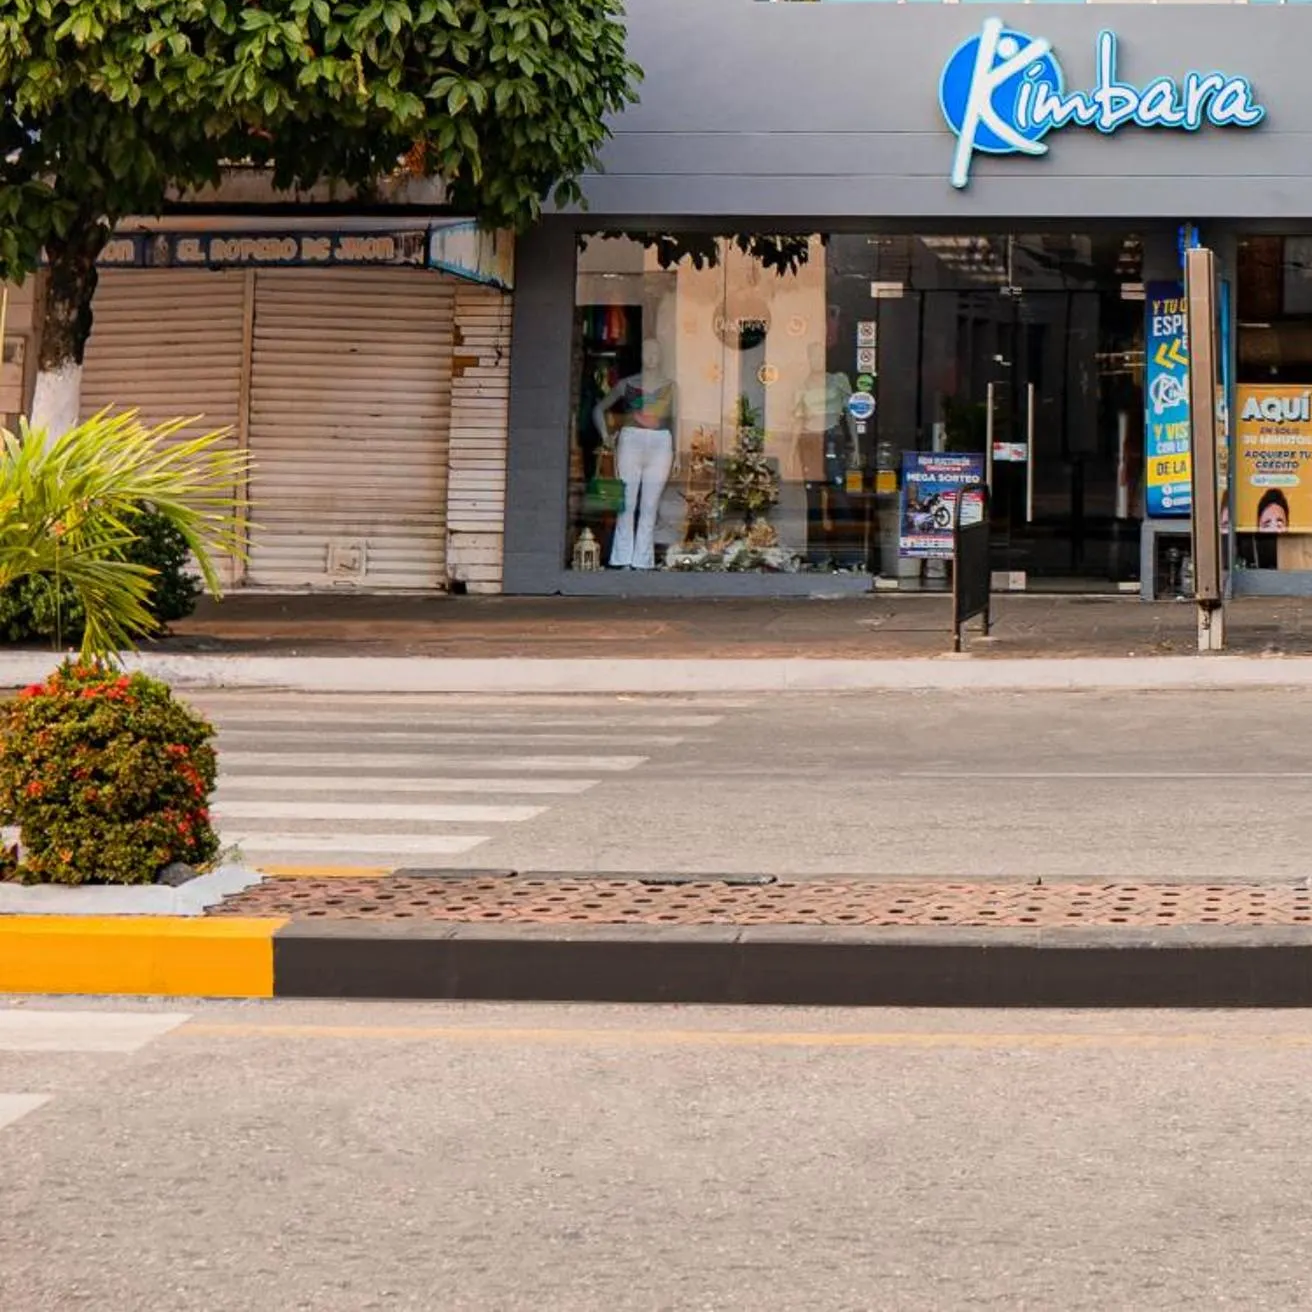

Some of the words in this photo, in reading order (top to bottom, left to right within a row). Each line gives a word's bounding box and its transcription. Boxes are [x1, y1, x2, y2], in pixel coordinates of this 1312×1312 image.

[946, 17, 1263, 188] Kimbara
[1241, 390, 1312, 424] AQUÍ
[940, 473, 980, 484] SORTEO
